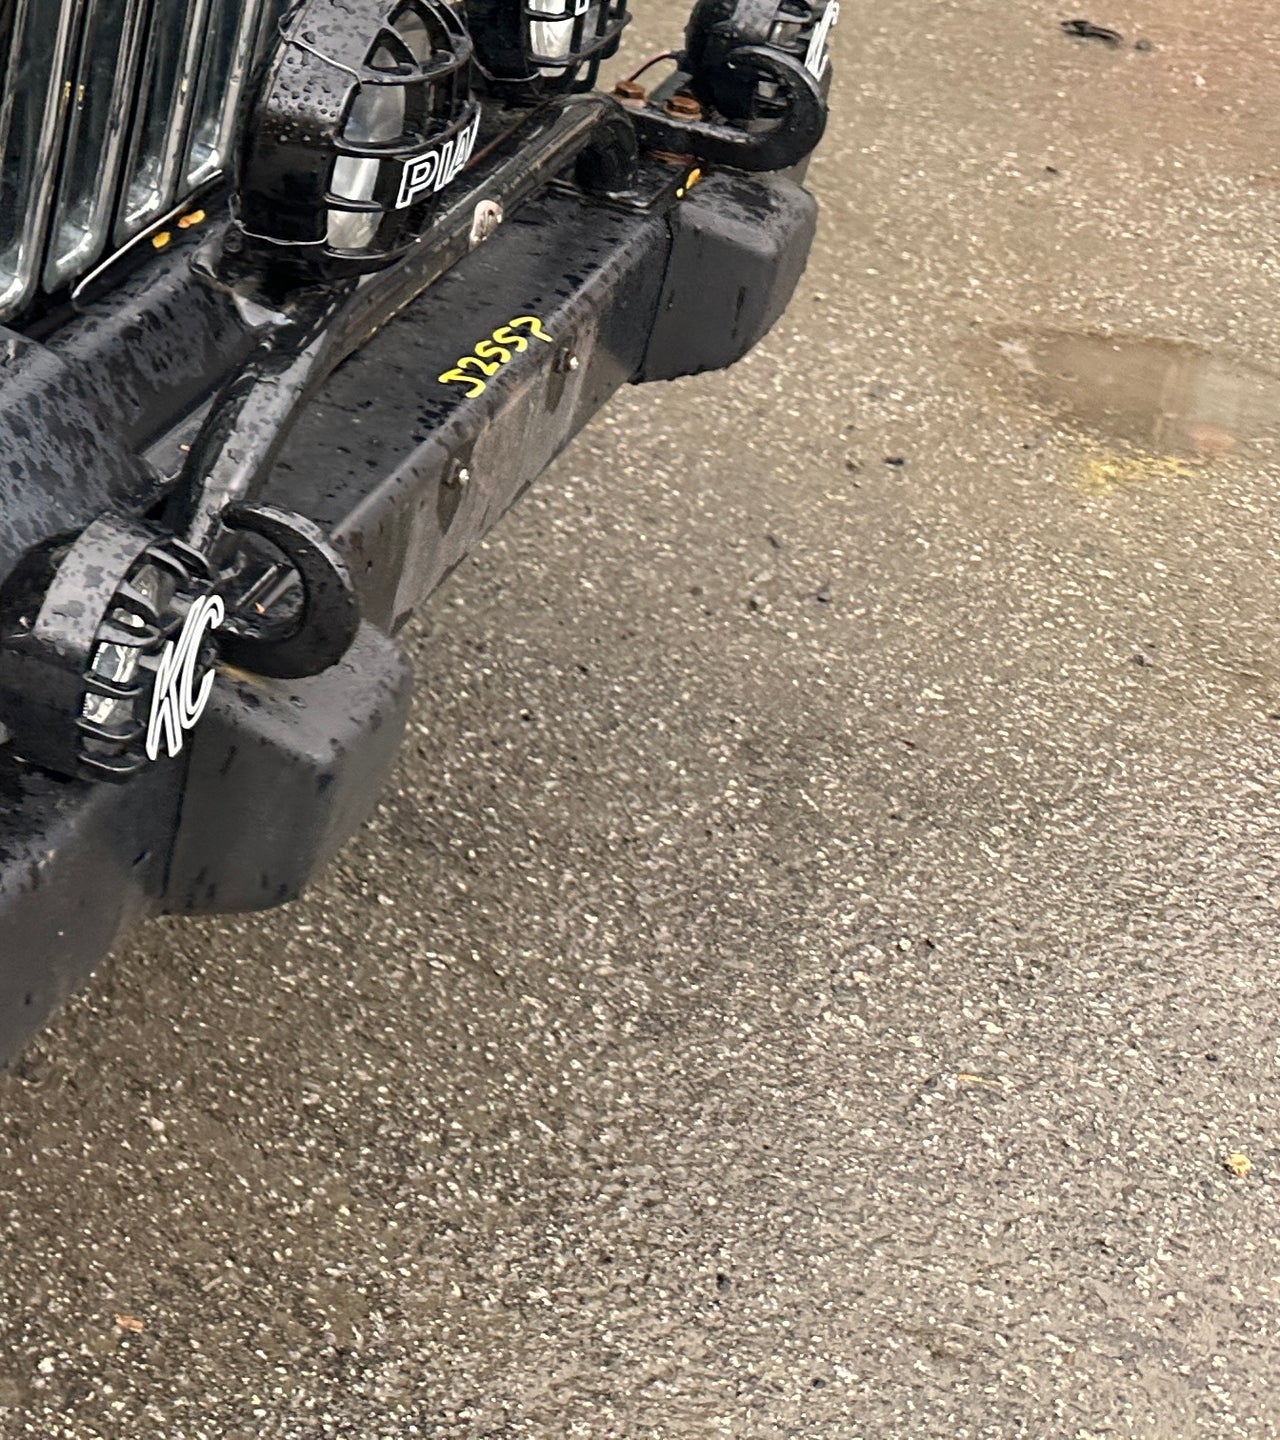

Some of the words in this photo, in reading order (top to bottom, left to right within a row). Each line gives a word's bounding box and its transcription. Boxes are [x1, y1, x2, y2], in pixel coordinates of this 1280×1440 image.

[395, 106, 481, 209] PIA
[438, 316, 553, 398] J2552
[146, 594, 225, 761] KC
